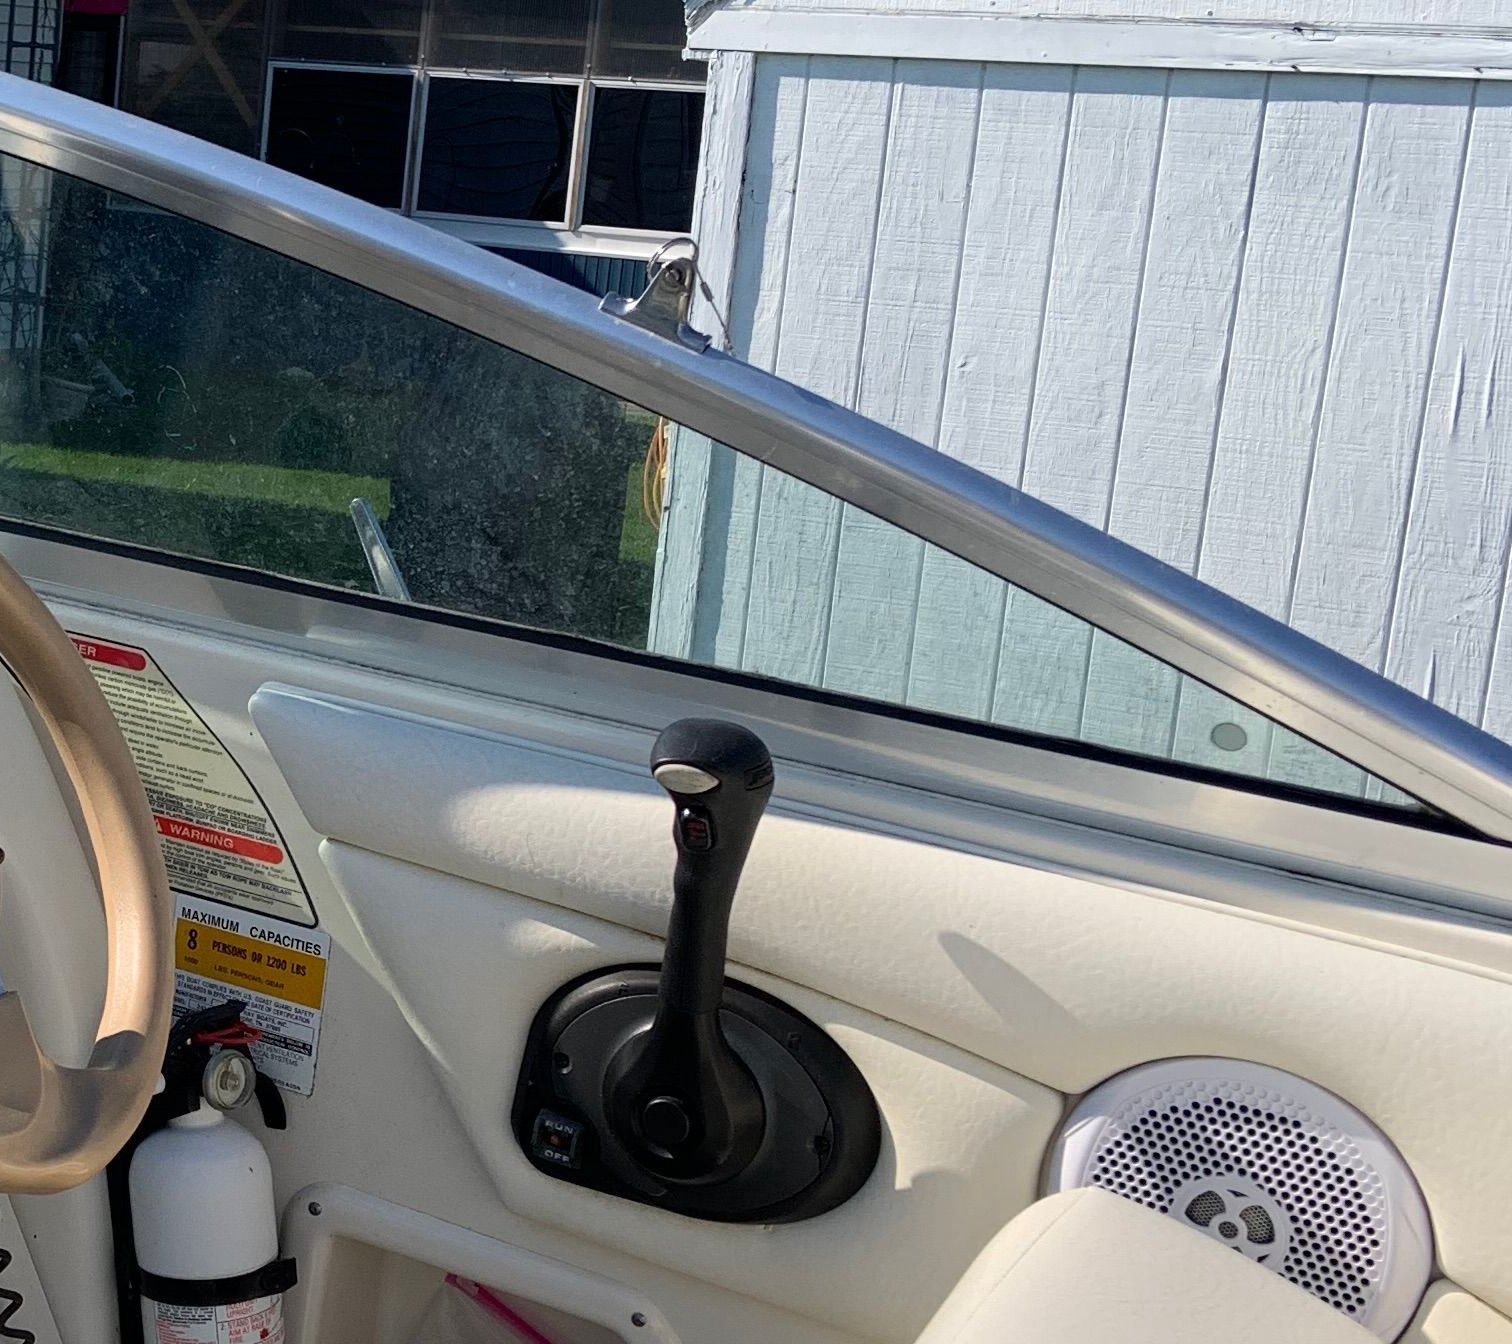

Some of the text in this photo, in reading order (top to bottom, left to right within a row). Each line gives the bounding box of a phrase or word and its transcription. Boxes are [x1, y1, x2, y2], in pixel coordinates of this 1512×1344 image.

[169, 823, 234, 849] WARNING
[182, 906, 321, 955] MAXIMUM CAPACITIES
[187, 926, 306, 976] 8 PERSONS OR 1200 LBS
[294, 1006, 314, 1018] SAFETY
[545, 1120, 573, 1134] RUN
[545, 1150, 569, 1162] OFF
